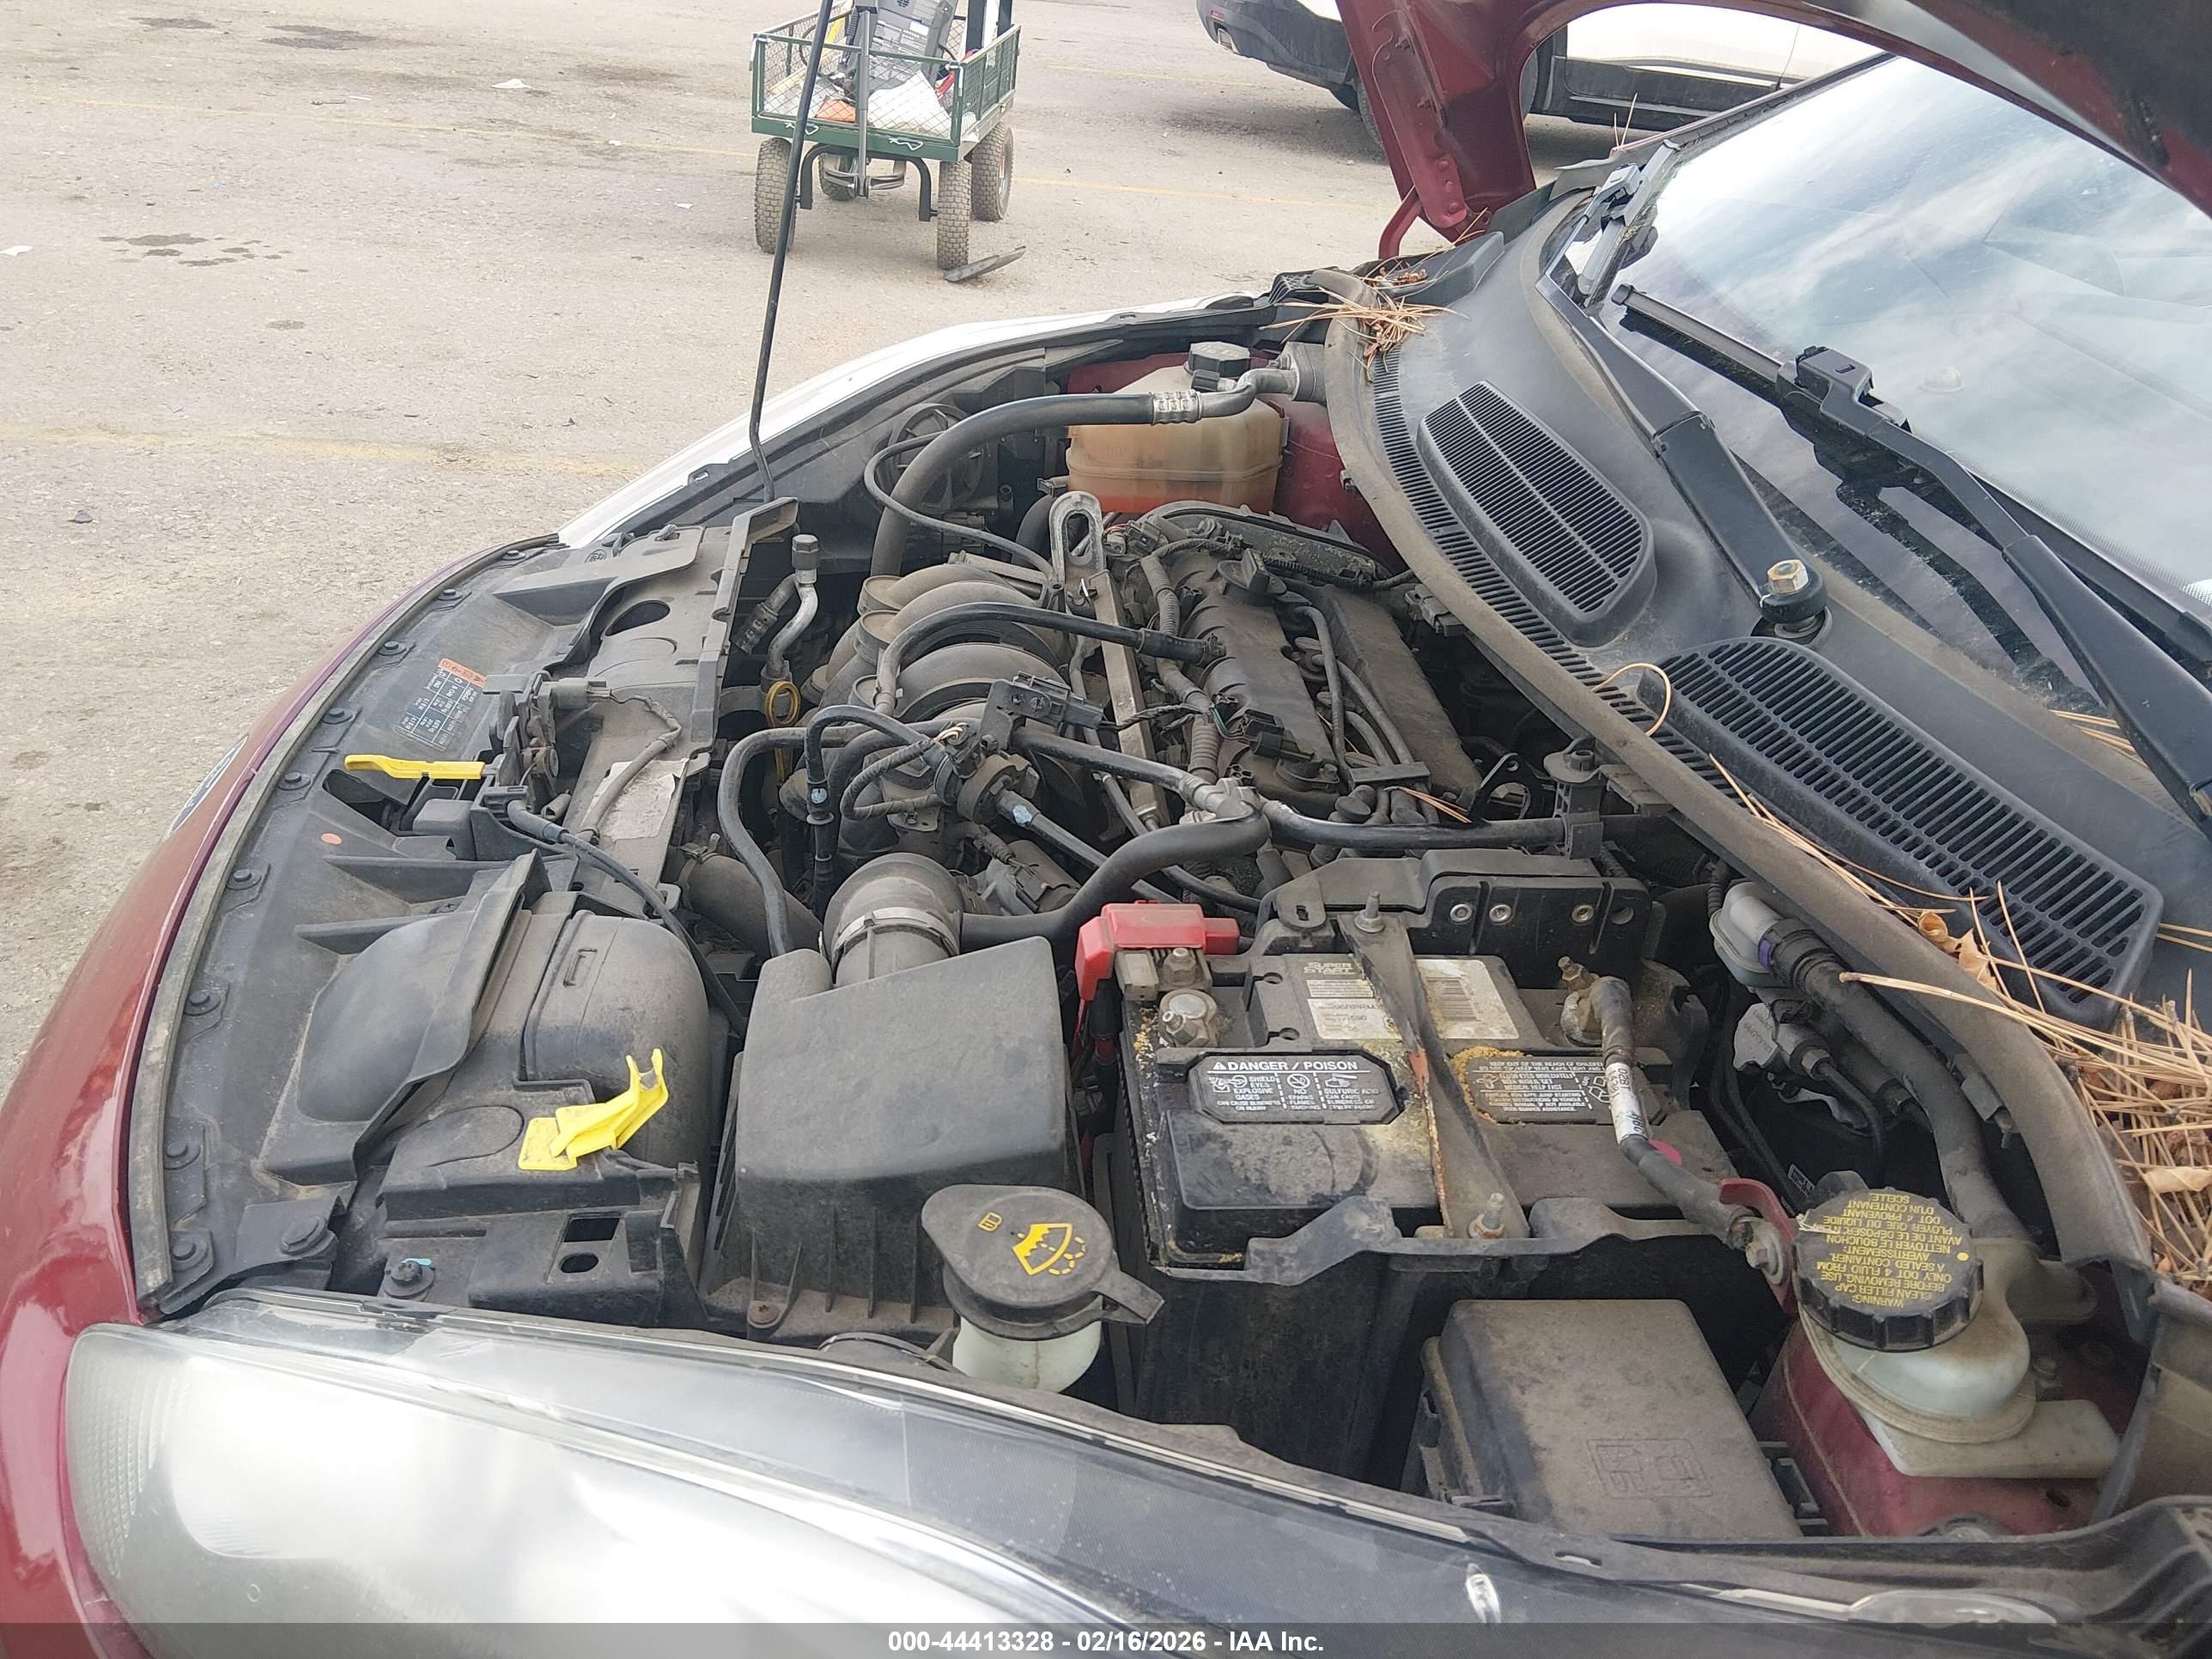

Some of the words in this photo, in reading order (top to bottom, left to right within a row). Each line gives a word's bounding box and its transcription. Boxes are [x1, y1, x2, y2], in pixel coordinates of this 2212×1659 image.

[1227, 1061, 1287, 1071] DANGER
[1304, 1061, 1358, 1070] POISON
[1846, 1200, 1908, 1212] CONTENANT
[1909, 1206, 1935, 1215] D'UN
[1841, 1208, 1902, 1220] PROVENANT
[1822, 1215, 1863, 1226] LIQUIDE
[1866, 1219, 1882, 1228] DU
[1919, 1215, 1941, 1224] DOT
[1885, 1220, 1908, 1231] QUE
[1911, 1223, 1953, 1235] PLOYER
[1897, 1231, 1909, 1240] LE
[1911, 1233, 1925, 1243] DE
[1929, 1235, 1962, 1245] AVANT
[1826, 1235, 1878, 1247] BOUCHON
[1881, 1240, 1893, 1249] LE
[1895, 1241, 1951, 1254] NETTOYER
[1843, 1246, 1930, 1261] AVERTISSEMENT:
[1817, 1261, 1847, 1271] FROM
[1850, 1266, 1881, 1274] FLUID
[1894, 1261, 1935, 1270] SEALED
[1820, 1271, 1842, 1281] USE
[1897, 1270, 1919, 1279] DOT
[1923, 1273, 1952, 1283] ONLY
[1834, 1283, 1857, 1293] CAP
[1902, 1279, 1945, 1291] BEFORE
[1858, 1285, 1893, 1296] FILLER
[1896, 1289, 1932, 1300] CLEAN
[1851, 1294, 1903, 1308] WARNING:
